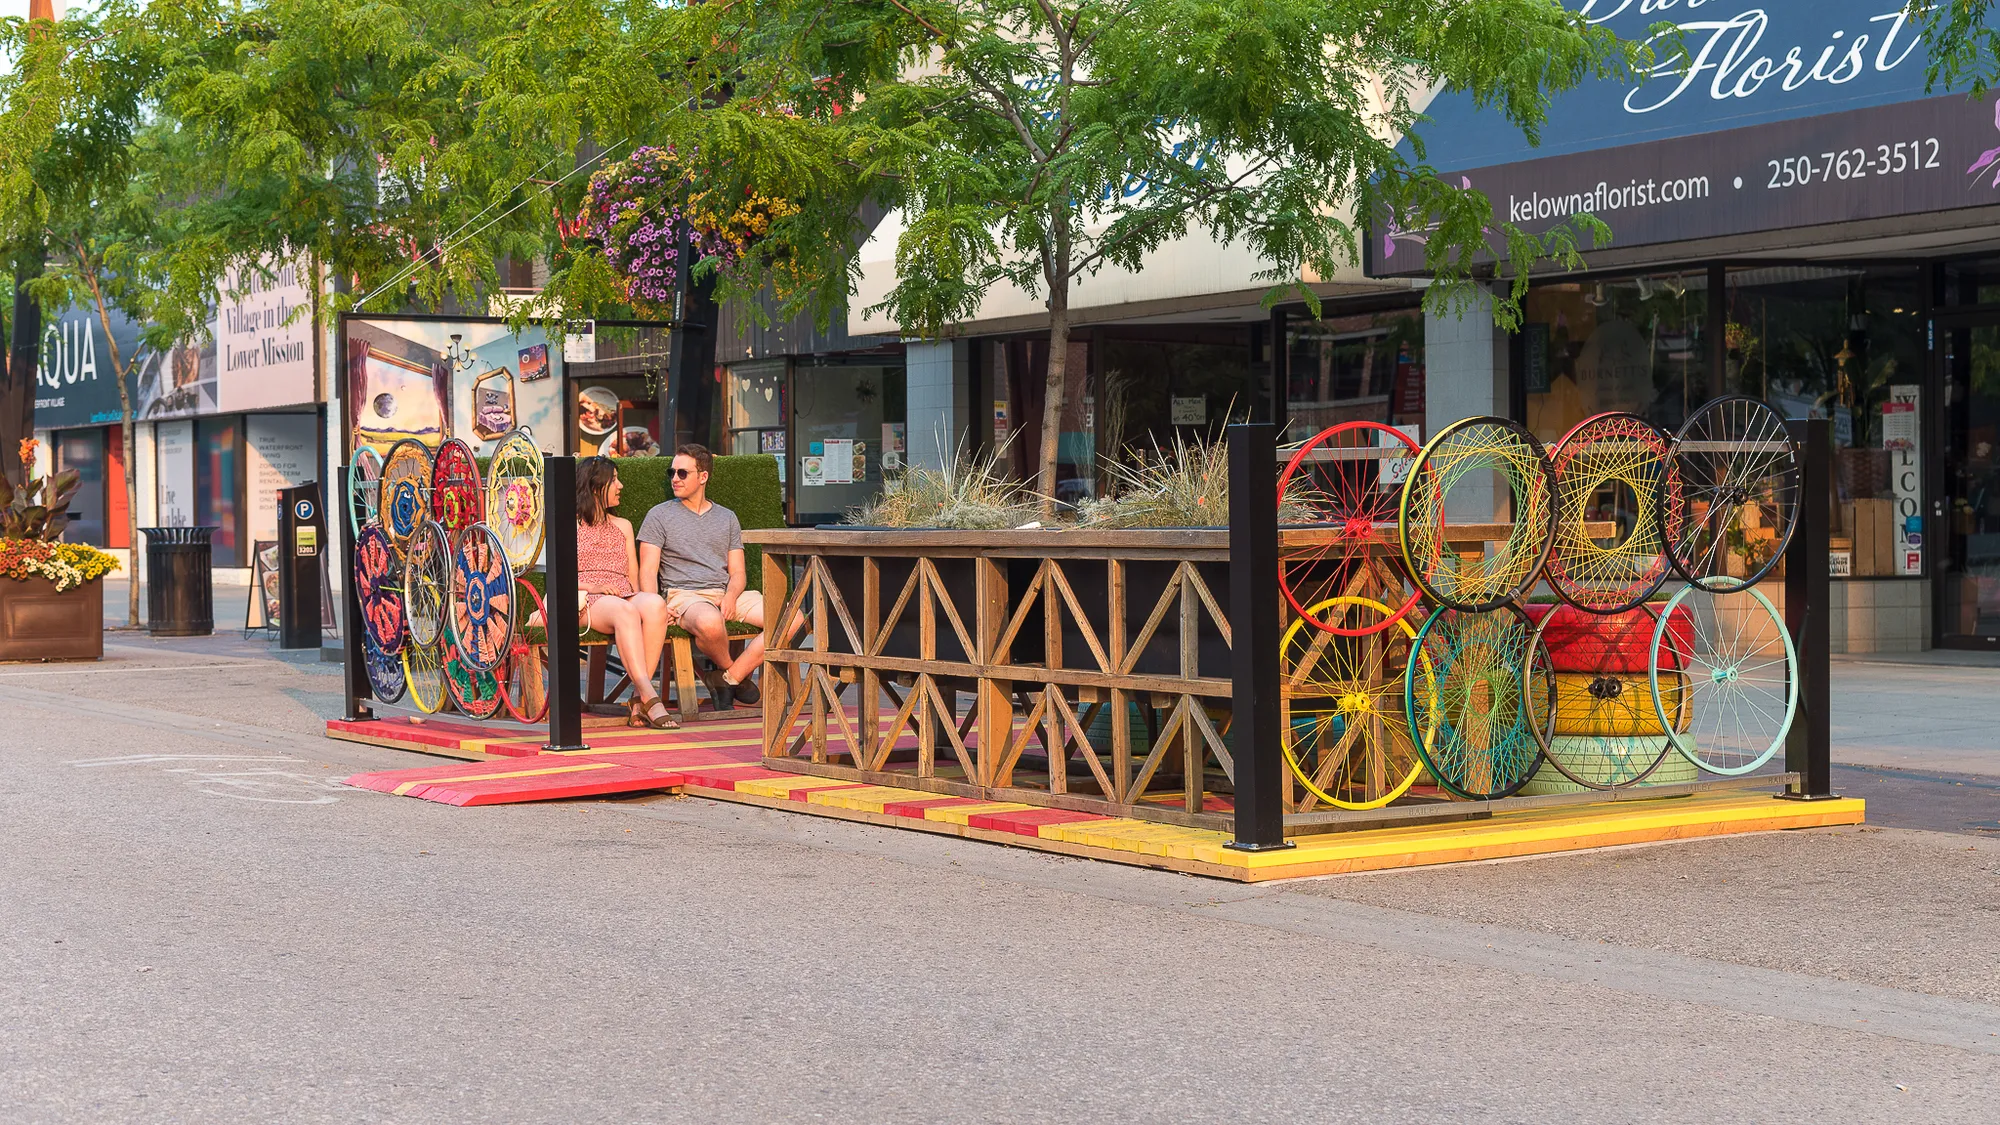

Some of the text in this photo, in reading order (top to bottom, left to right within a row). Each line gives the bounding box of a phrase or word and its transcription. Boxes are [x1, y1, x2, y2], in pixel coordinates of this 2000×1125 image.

[1623, 8, 1938, 113] Florist
[1509, 137, 1940, 222] kelownaflorist.com 250-762-3512
[226, 296, 296, 340] Village in the
[226, 334, 304, 371] Lower Mission
[300, 503, 309, 516] P
